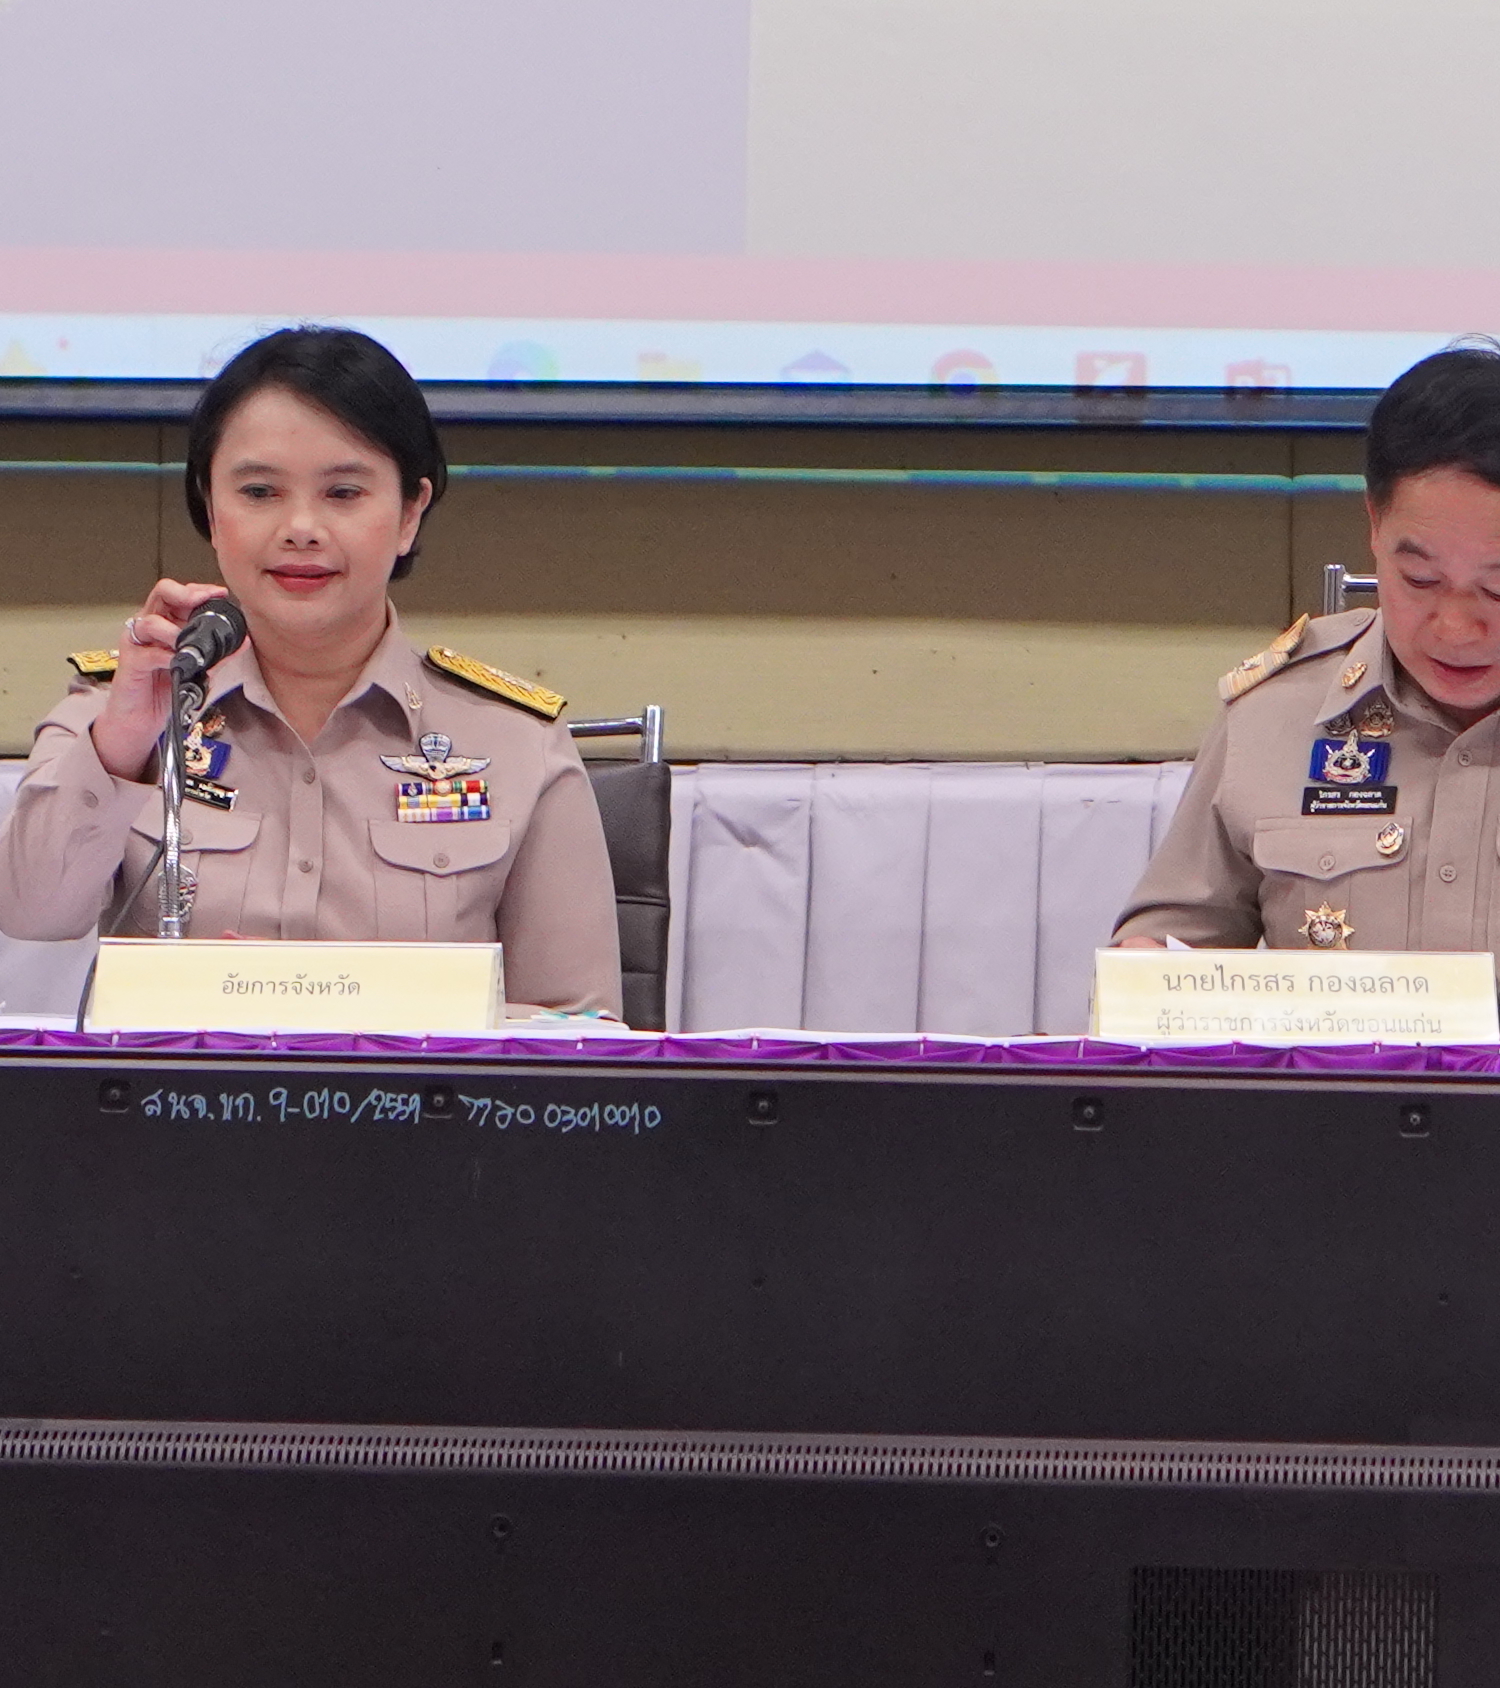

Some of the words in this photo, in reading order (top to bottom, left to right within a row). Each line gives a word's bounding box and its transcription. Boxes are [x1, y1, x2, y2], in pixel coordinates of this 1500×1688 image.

[221, 972, 362, 997] อัยการจังหวัด
[1162, 963, 1296, 994] นายไกรสร
[1308, 973, 1431, 995] กองฉลาด
[1156, 1008, 1444, 1036] ผู้ว่าราชการจังหวัดขอนแก่น
